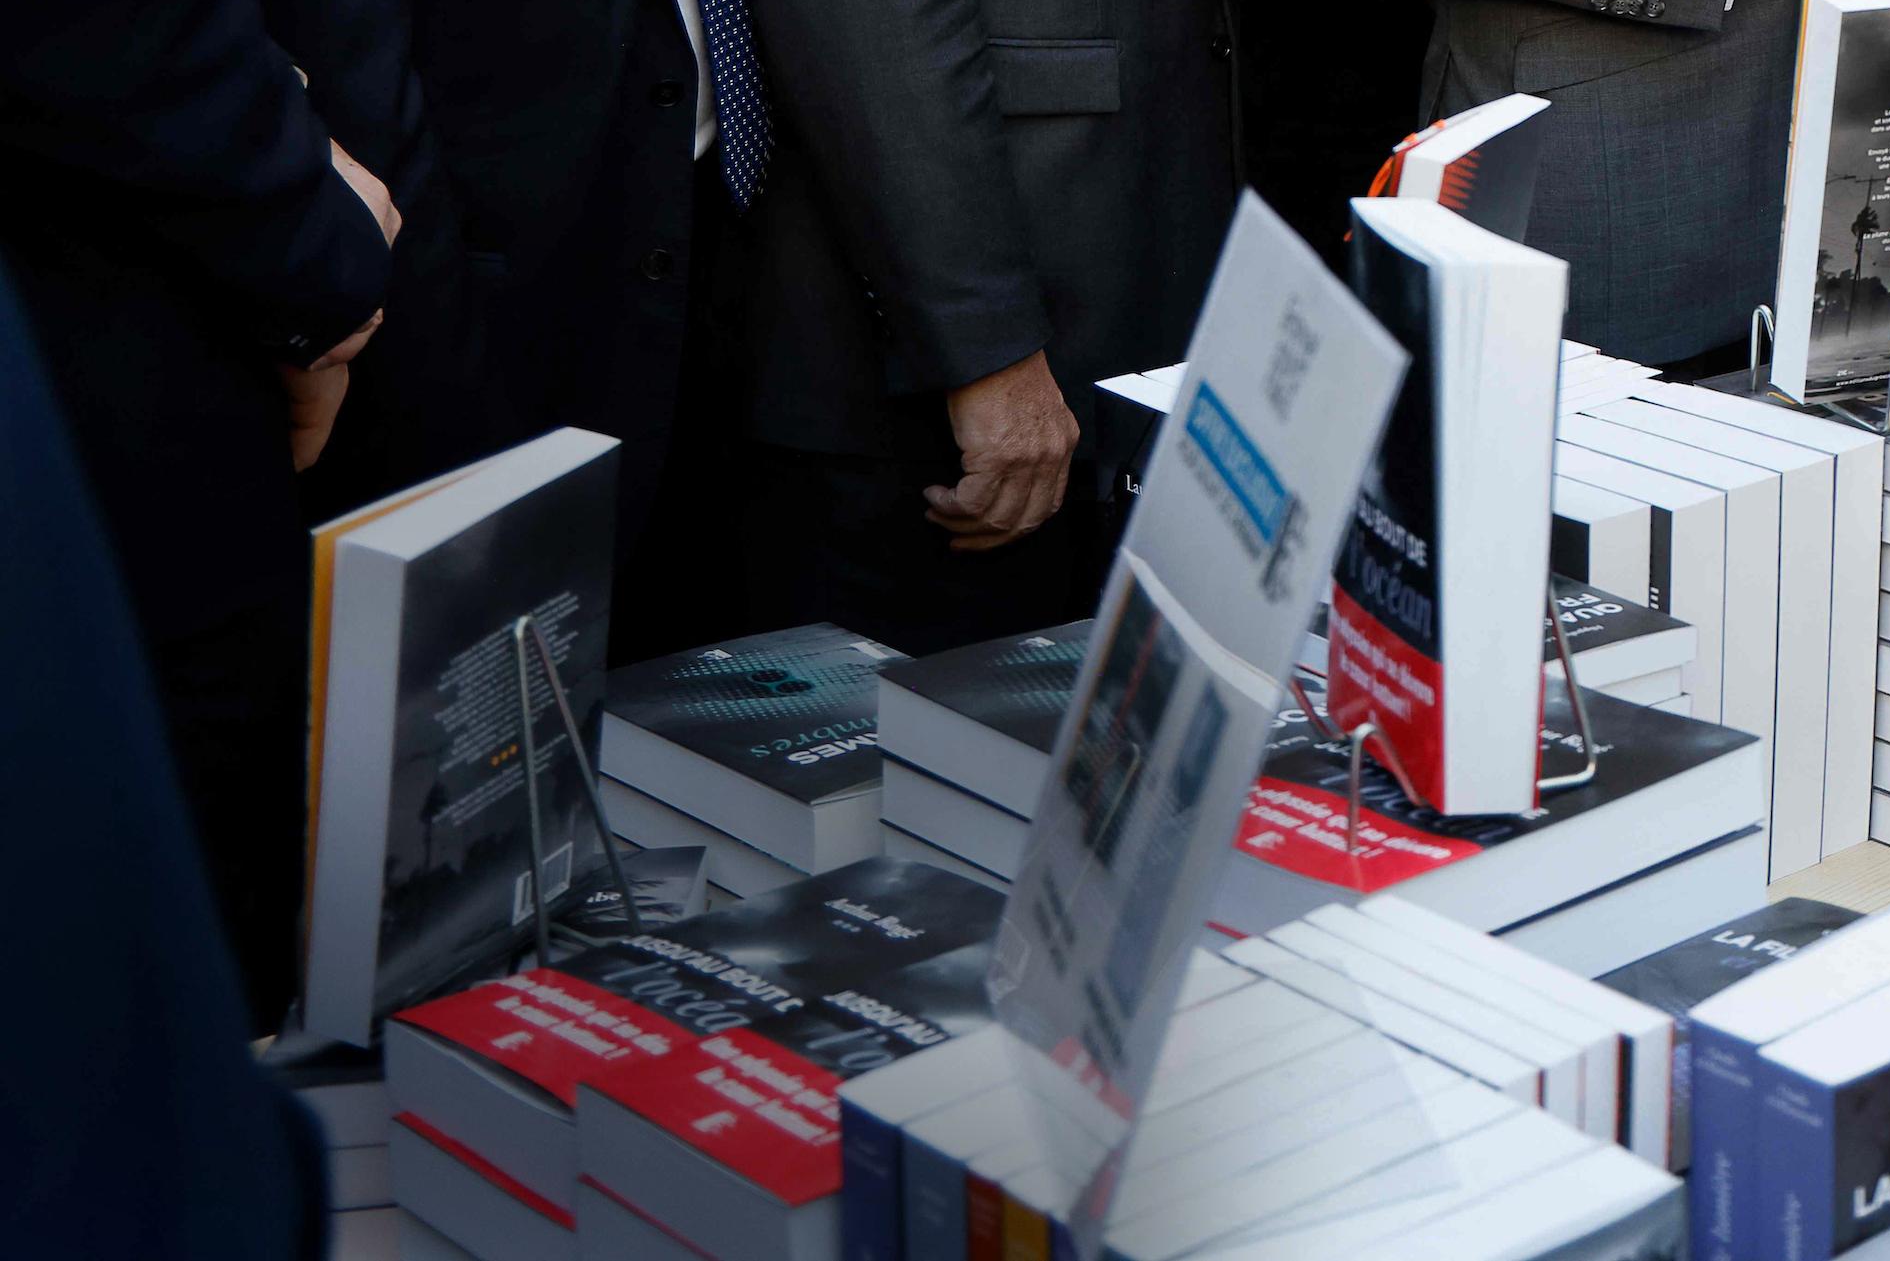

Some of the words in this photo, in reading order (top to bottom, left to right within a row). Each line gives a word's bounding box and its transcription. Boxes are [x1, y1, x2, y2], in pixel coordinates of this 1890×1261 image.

[1712, 928, 1757, 952] LA
[1750, 934, 1800, 961] FIL
[603, 961, 751, 1034] l'océa
[718, 967, 790, 1002] BOUT
